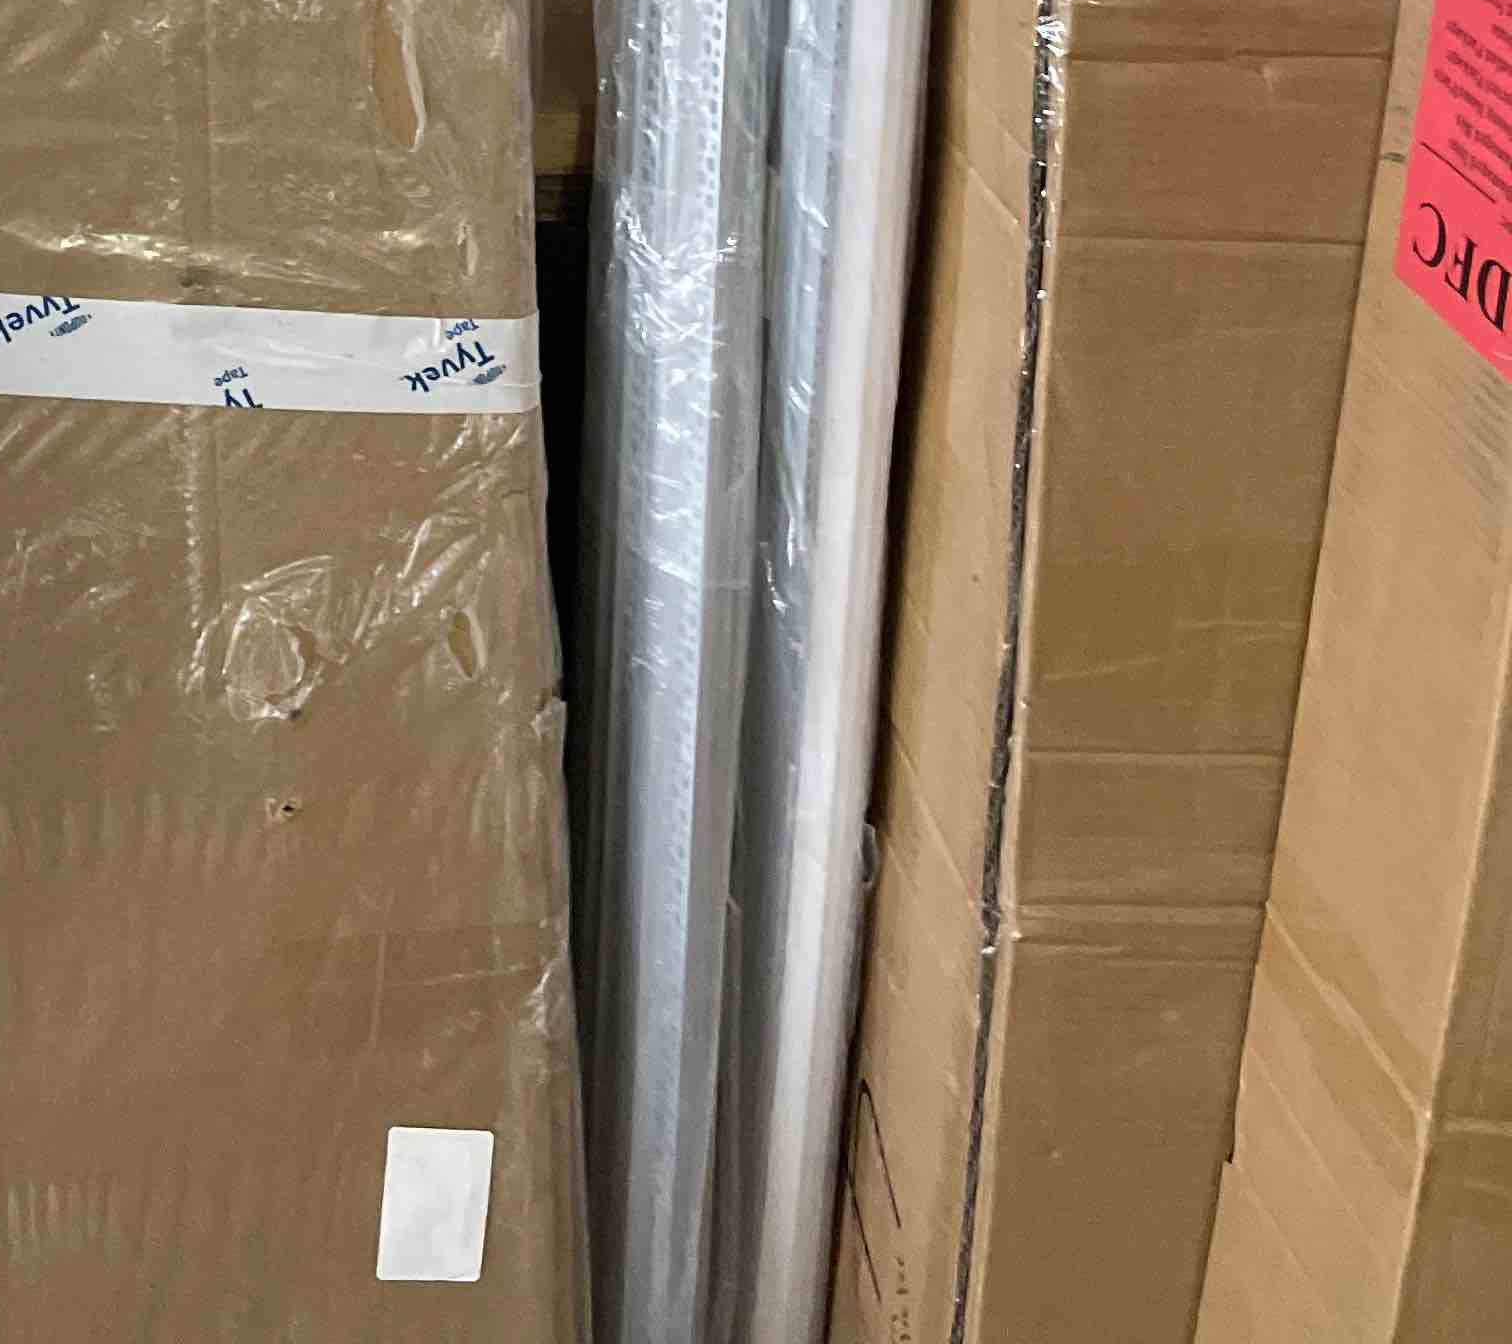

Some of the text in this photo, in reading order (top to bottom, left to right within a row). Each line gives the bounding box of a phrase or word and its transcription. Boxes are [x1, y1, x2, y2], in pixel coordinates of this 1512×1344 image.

[1413, 202, 1512, 333] DFC
[445, 319, 478, 340] Tape
[215, 365, 248, 386] Tape
[404, 340, 505, 393] Tyvek
